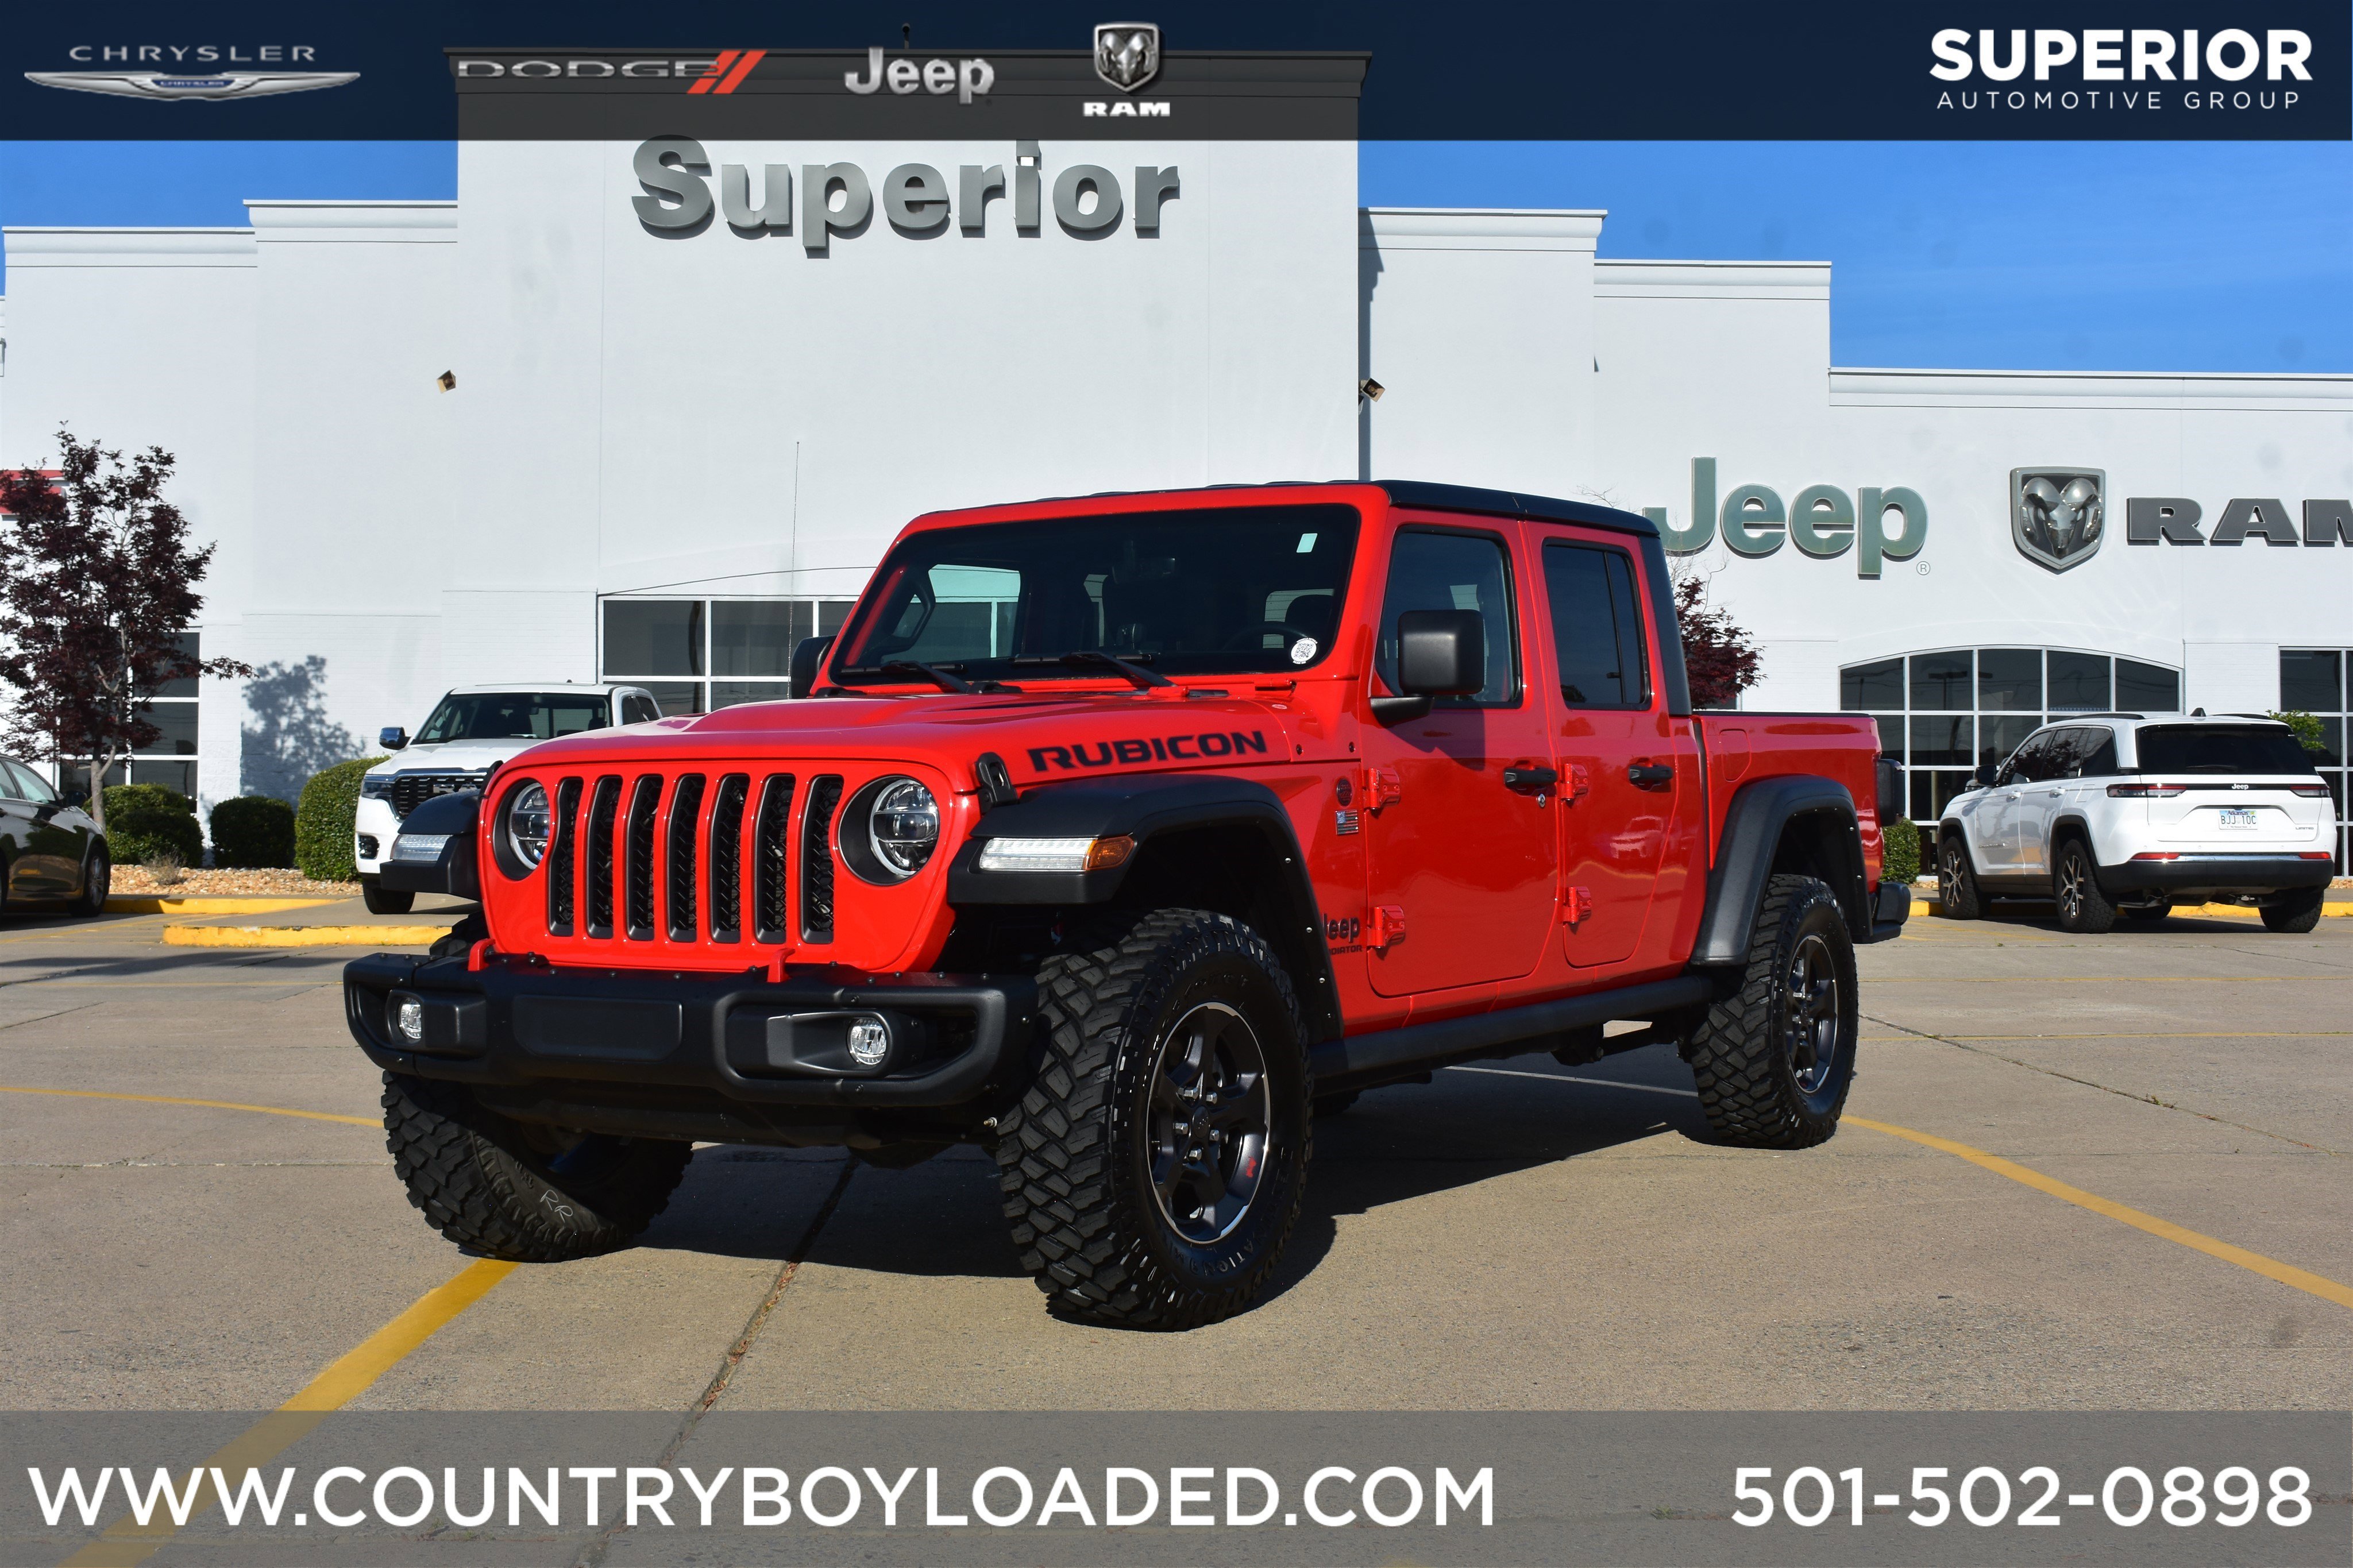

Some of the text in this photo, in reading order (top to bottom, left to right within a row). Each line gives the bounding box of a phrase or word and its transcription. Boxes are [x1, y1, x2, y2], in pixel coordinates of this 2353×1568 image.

[632, 136, 1179, 250] Superior
[1642, 457, 1928, 577] Jeep
[1027, 730, 1267, 773] RUBICON
[2221, 815, 2236, 825] BJJ
[1329, 944, 1363, 956] DIATOR
